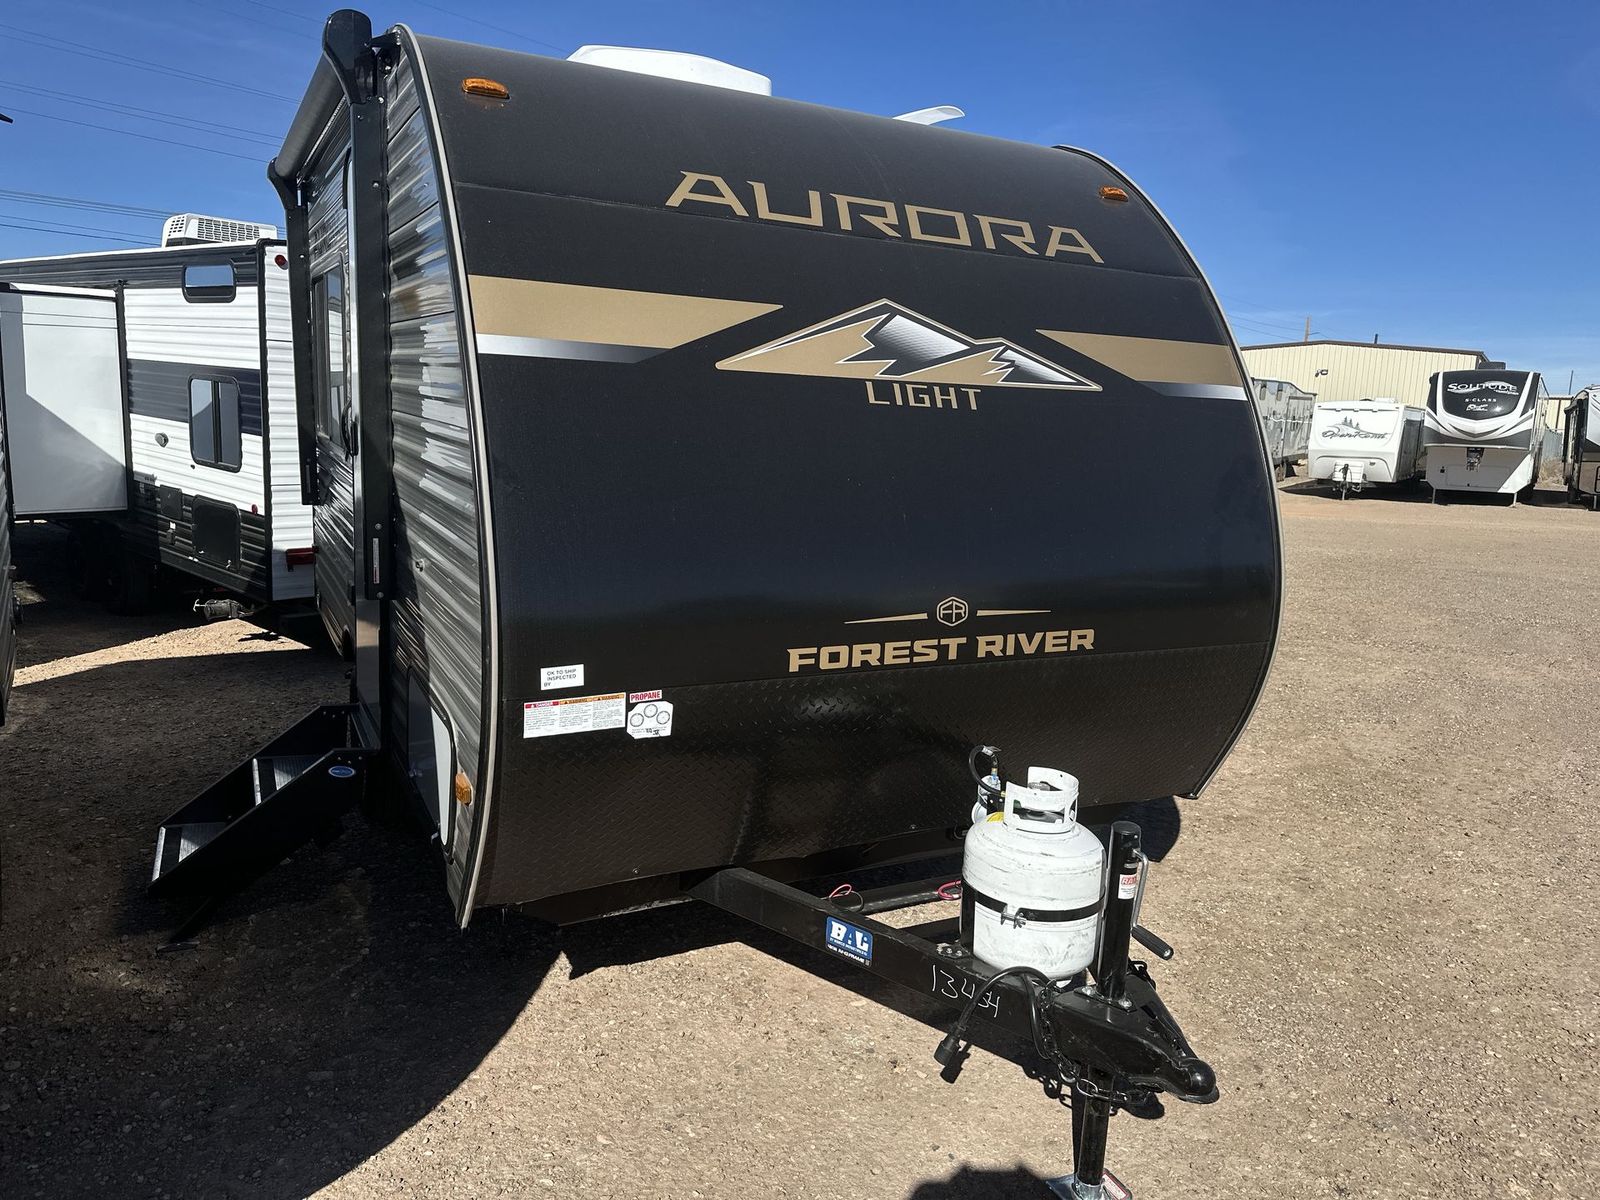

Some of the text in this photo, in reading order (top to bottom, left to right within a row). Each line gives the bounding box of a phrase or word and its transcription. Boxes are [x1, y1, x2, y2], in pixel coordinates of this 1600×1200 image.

[665, 170, 1105, 264] AURORA
[865, 381, 982, 411] LIGHT
[1447, 383, 1518, 392] SOLITUDE
[787, 628, 1095, 673] FOREST RIVER
[630, 690, 661, 702] PROPANE
